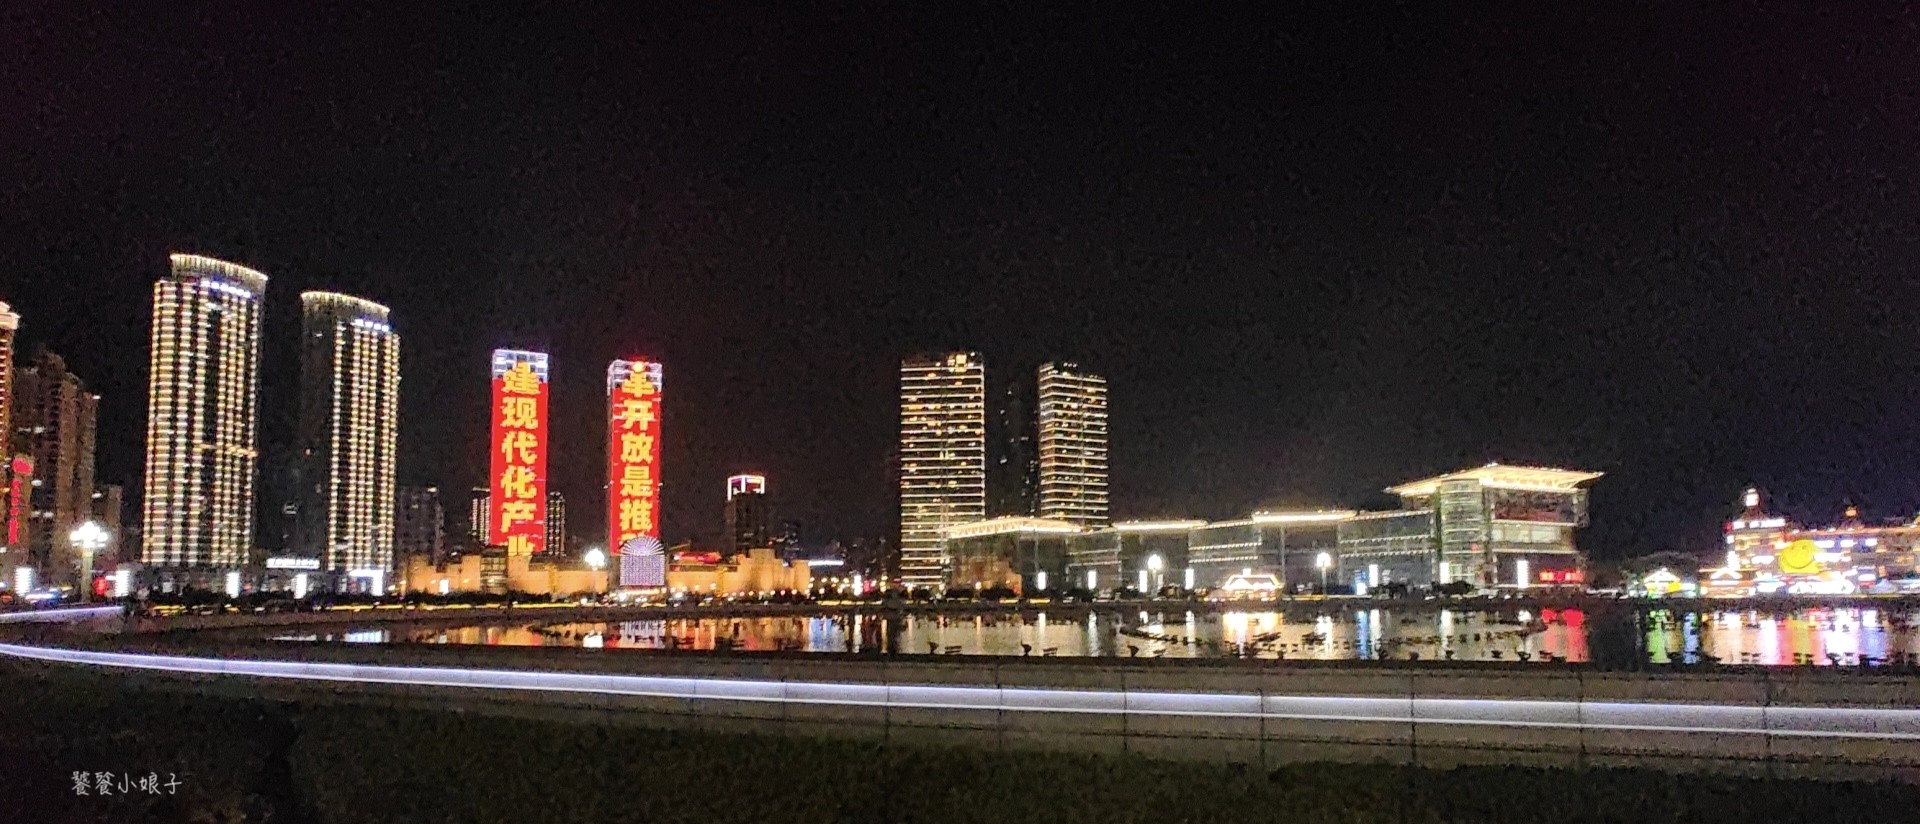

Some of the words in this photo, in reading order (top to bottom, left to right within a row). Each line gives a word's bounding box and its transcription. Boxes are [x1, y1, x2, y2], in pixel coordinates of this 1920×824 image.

[619, 362, 655, 546] 革开放是推
